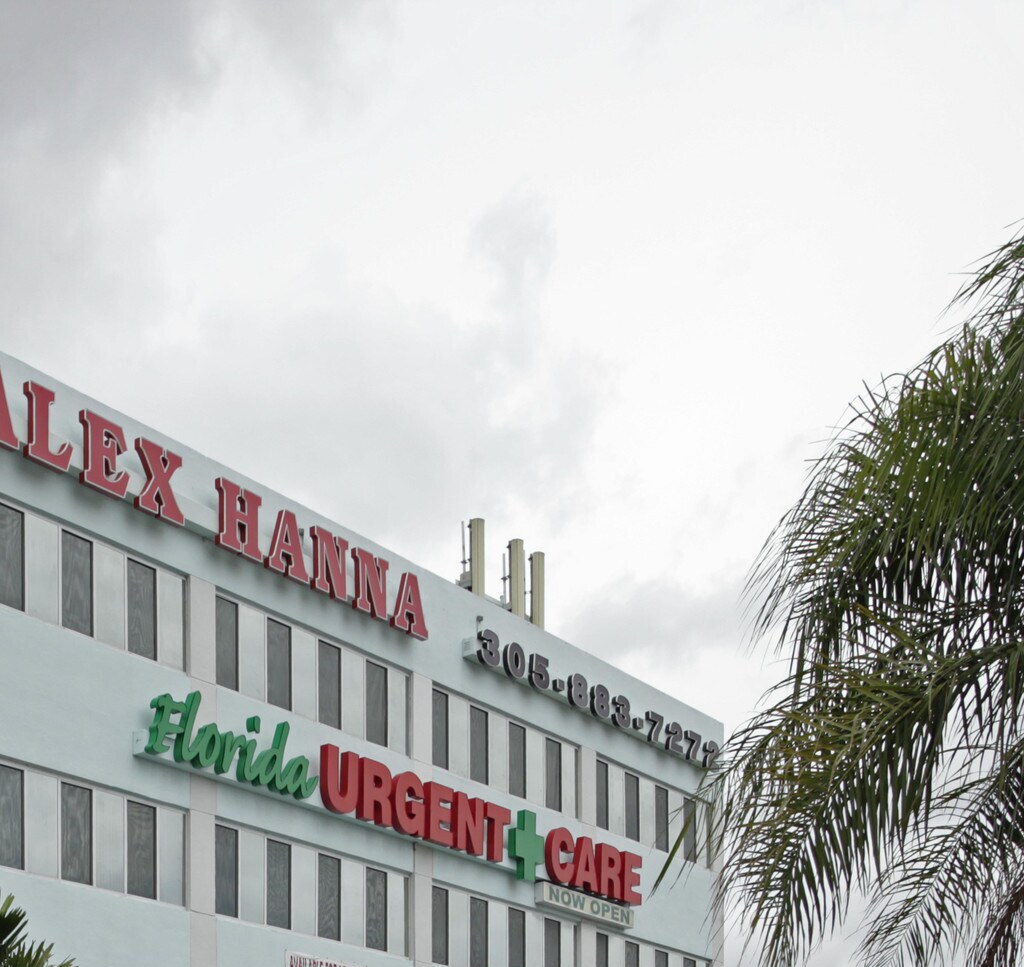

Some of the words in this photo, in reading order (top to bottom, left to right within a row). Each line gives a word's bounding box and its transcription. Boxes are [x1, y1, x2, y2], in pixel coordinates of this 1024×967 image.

[215, 476, 429, 641] HANNA
[144, 690, 319, 799] Florida
[320, 744, 511, 862] URGENT
[544, 826, 642, 906] CARE
[549, 886, 585, 910] NOW
[590, 899, 631, 925] OPEN
